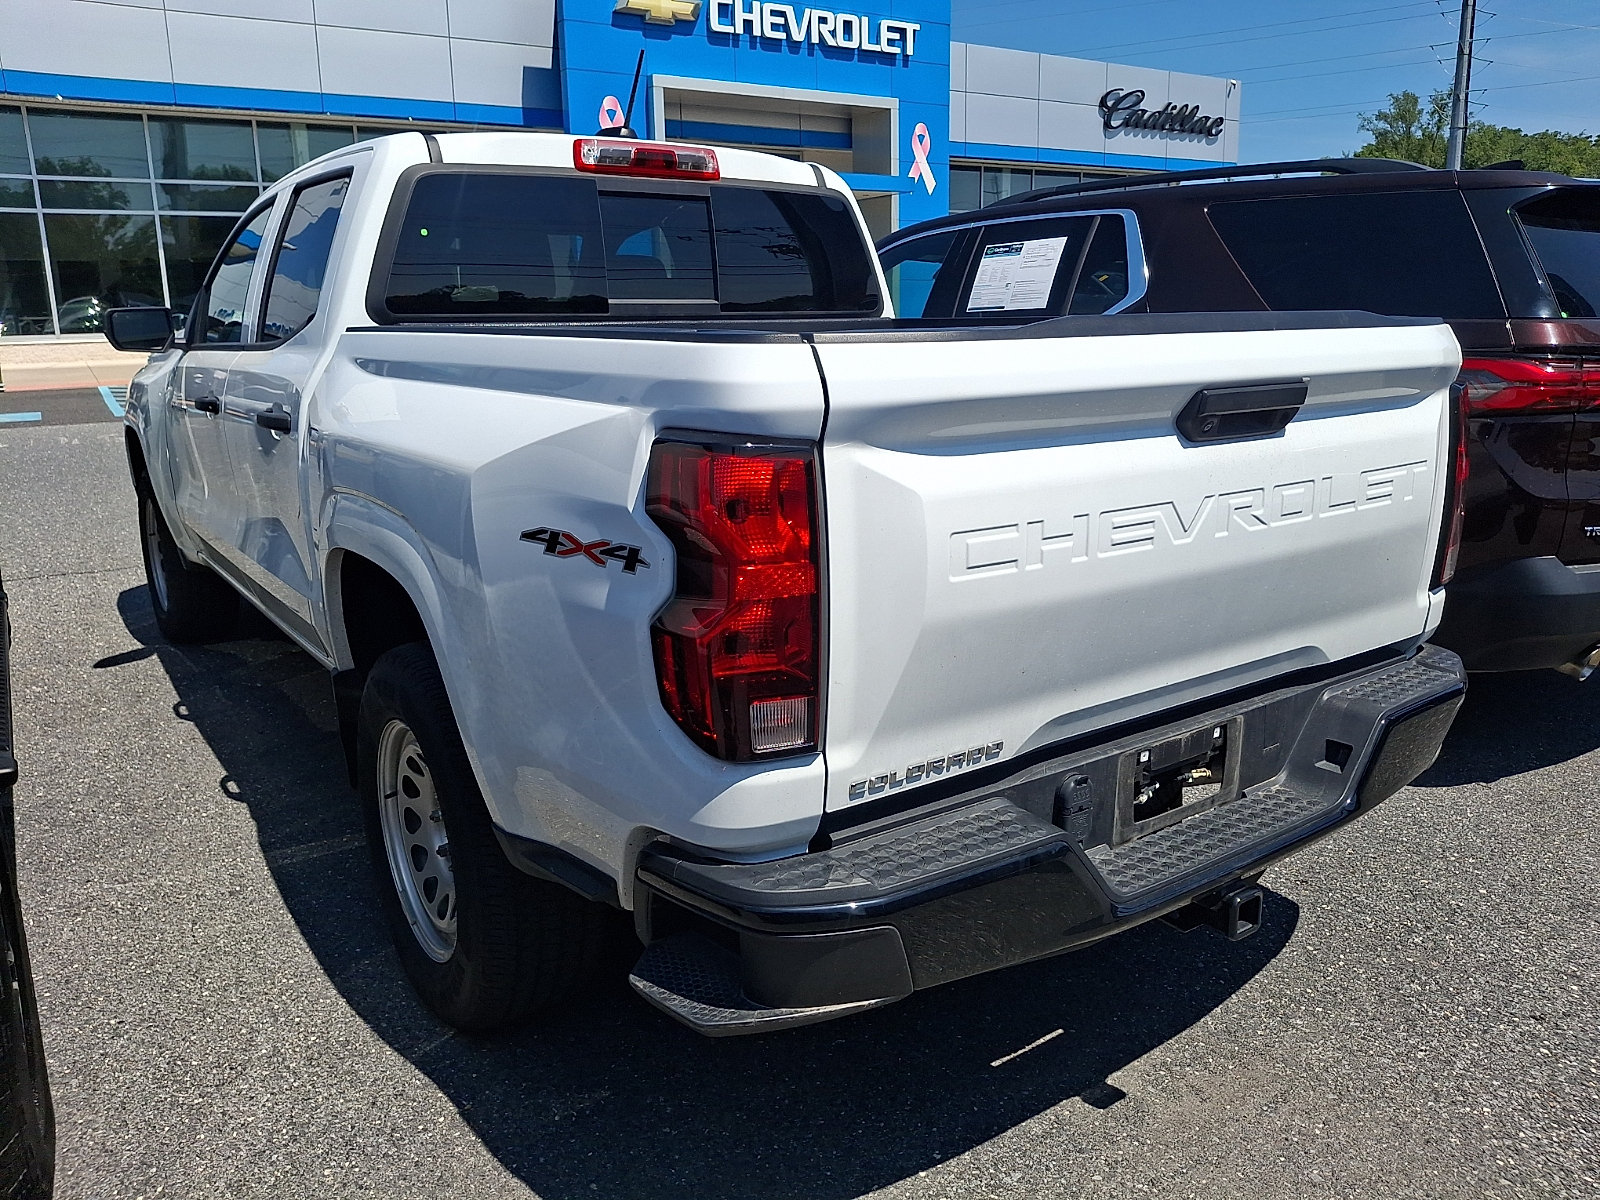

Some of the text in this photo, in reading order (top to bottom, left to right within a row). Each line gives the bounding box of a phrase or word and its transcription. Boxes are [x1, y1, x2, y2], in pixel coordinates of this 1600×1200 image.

[709, 0, 920, 56] CHEVROLET
[1099, 88, 1225, 137] Cadillac
[949, 460, 1428, 583] CHEVROLET
[848, 740, 1004, 802] COLORADO
